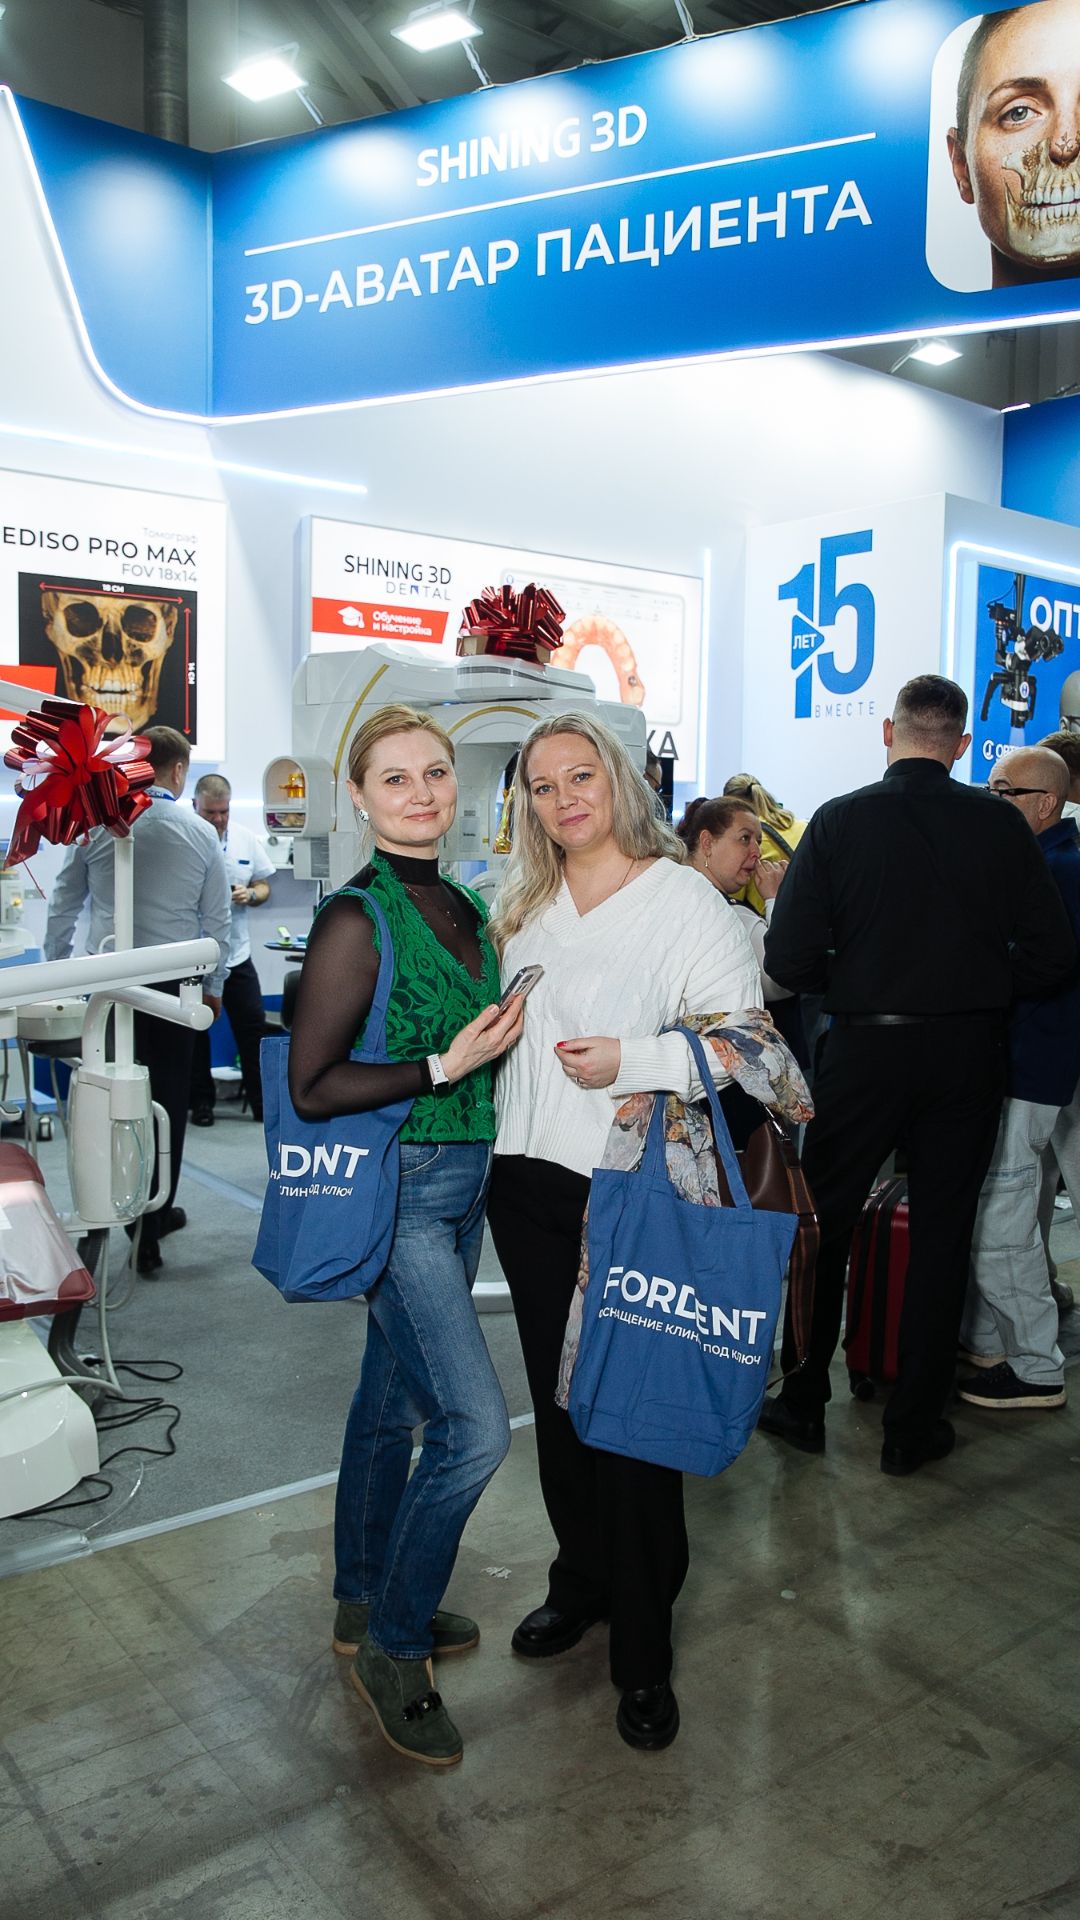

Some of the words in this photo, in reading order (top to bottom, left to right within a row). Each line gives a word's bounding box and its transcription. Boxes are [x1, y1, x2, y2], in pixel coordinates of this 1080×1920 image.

[416, 116, 582, 188] SHINING
[589, 104, 648, 153] 3D
[244, 239, 520, 325] 3D-АВАТАР
[536, 180, 873, 277] ПАЦИЕНТА
[3, 526, 80, 552] EDISO
[88, 537, 138, 559] PRO
[147, 545, 197, 567] MAX
[121, 563, 155, 578] FOV
[158, 567, 197, 583] 18x14
[344, 554, 423, 582] SHINING
[428, 565, 452, 585] 3D
[385, 581, 452, 600] DENTAL
[372, 610, 422, 627] Обучение
[778, 528, 876, 720] 15
[381, 623, 432, 637] настройка
[793, 633, 817, 650] ЛЕТ
[814, 700, 876, 718] ВМЕСТЕ
[603, 1266, 767, 1345] FORDENT
[703, 1343, 730, 1359] ПОД
[731, 1349, 762, 1365] КЛЮЧ
